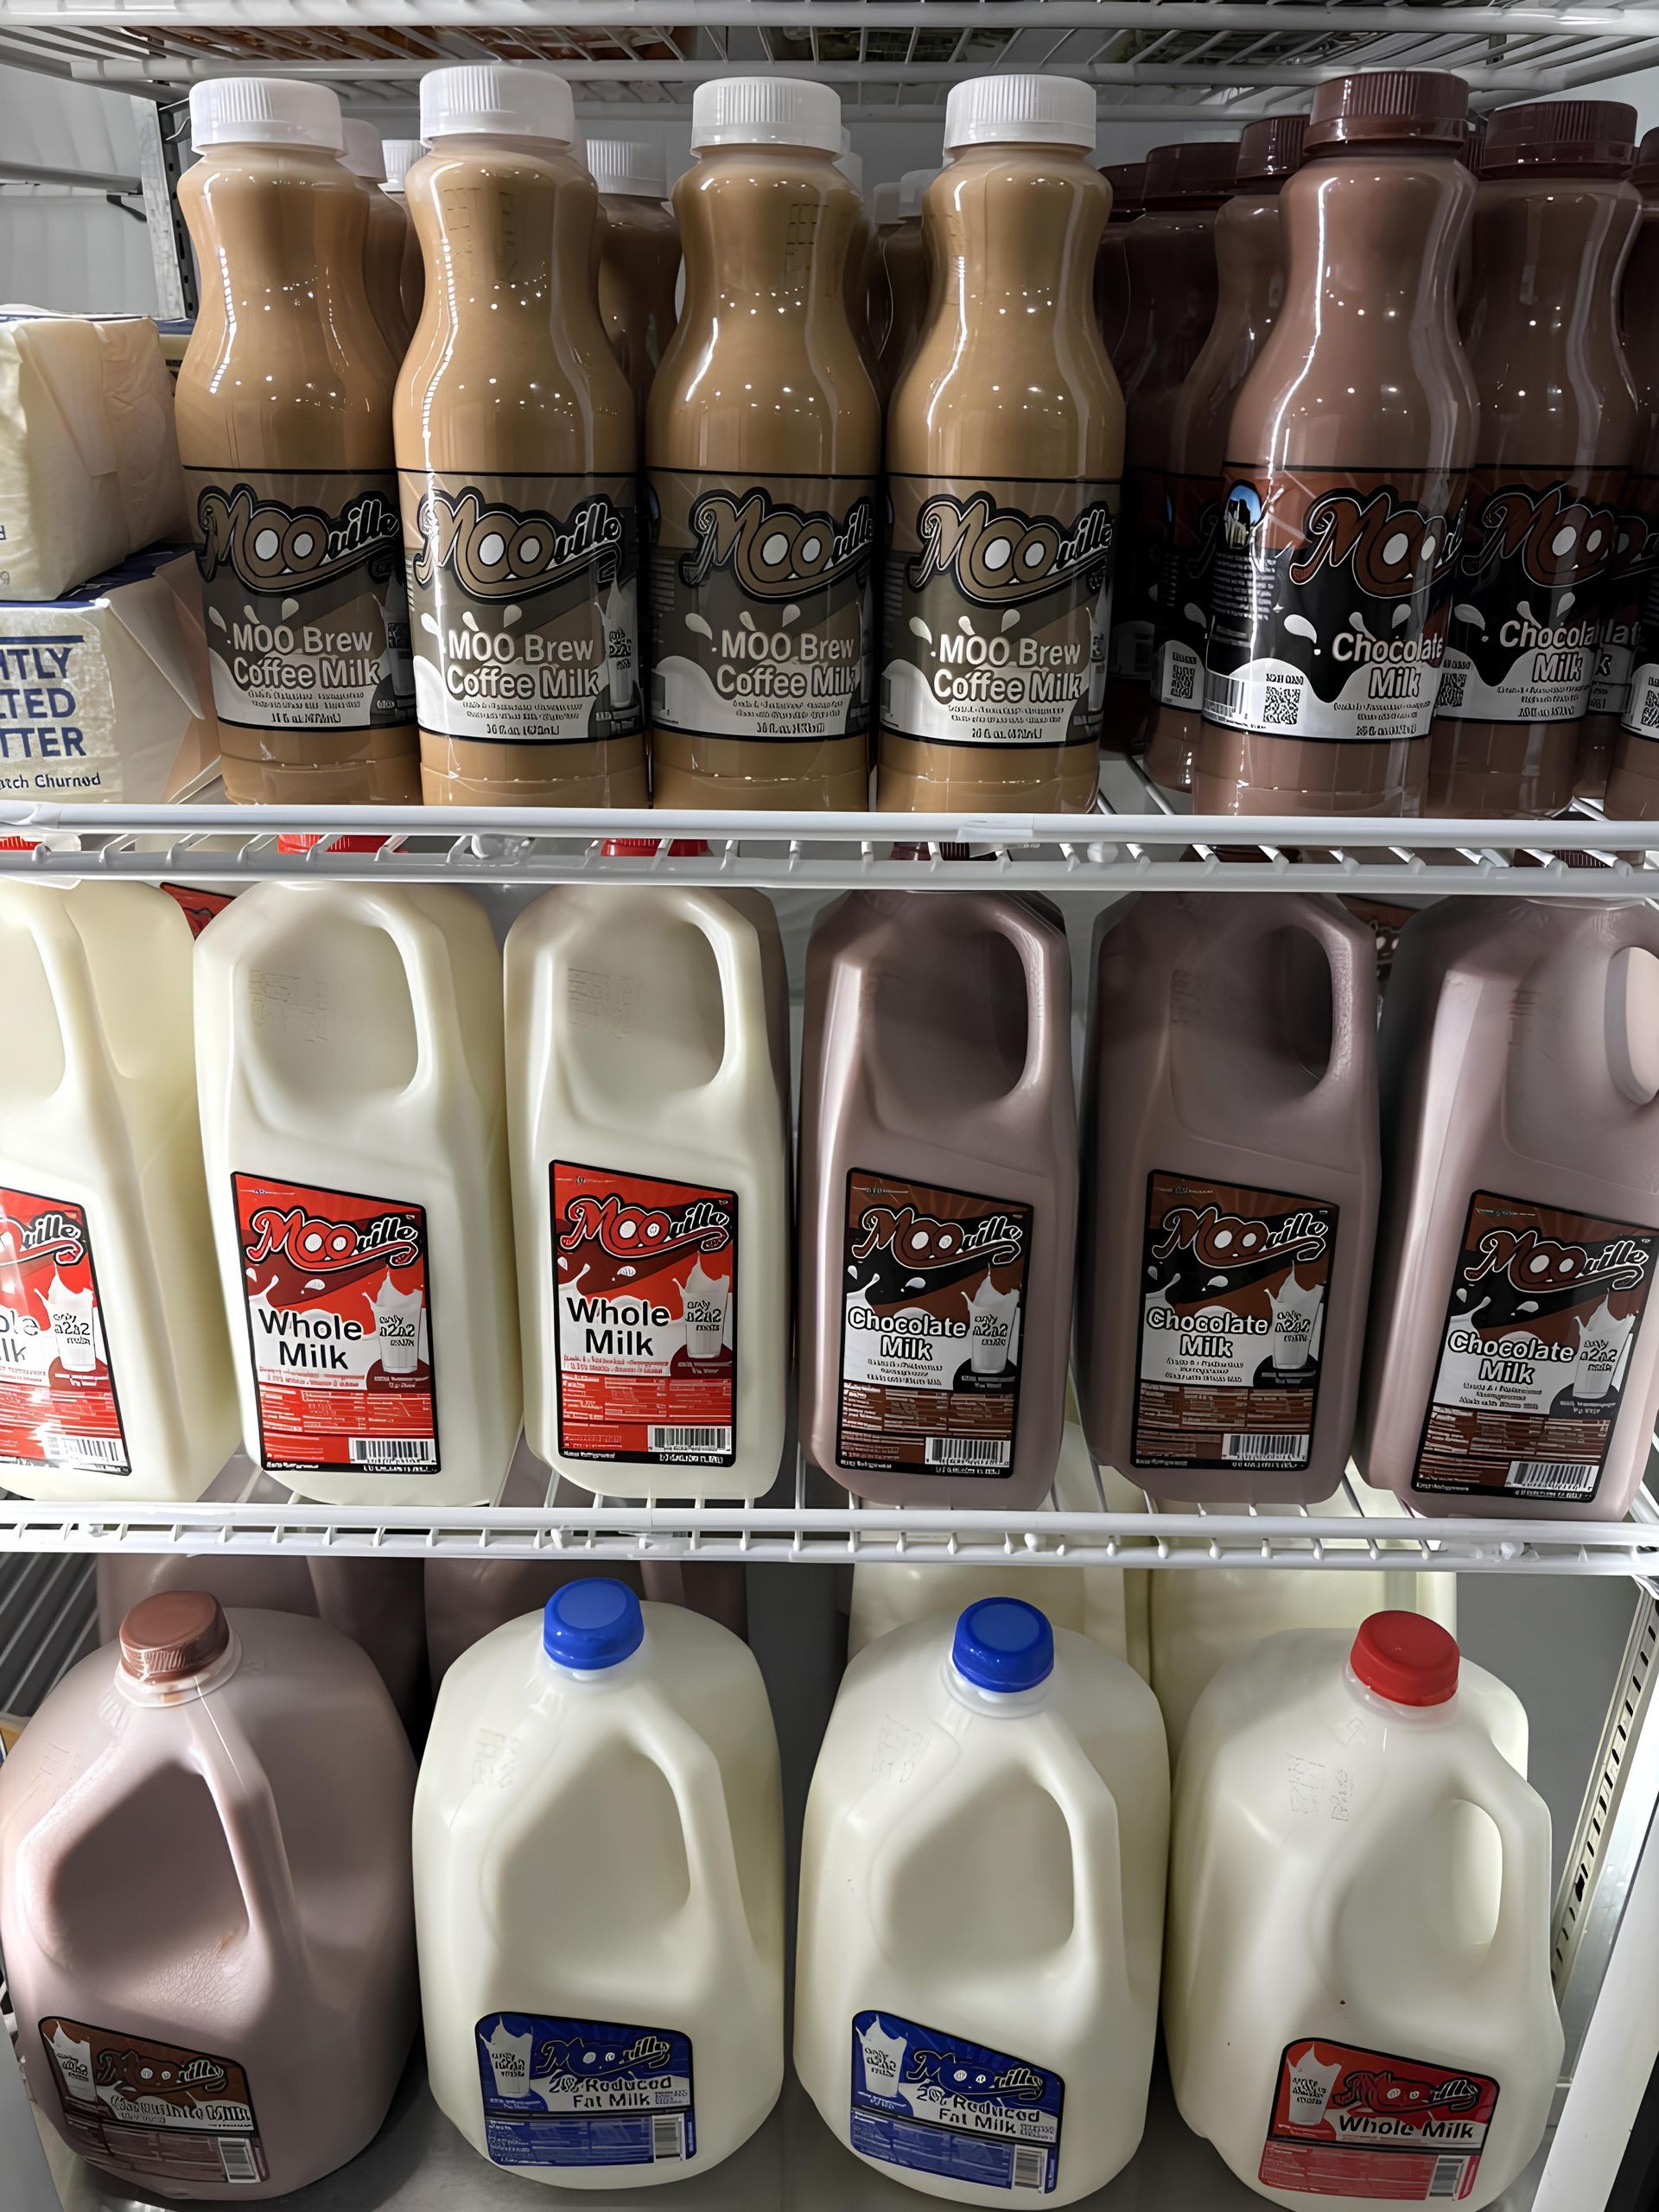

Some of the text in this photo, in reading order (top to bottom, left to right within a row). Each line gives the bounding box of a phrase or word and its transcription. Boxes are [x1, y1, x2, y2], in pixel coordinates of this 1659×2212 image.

[232, 624, 374, 654] MOO Brew
[448, 629, 516, 664] MOO
[524, 633, 594, 663] Brew
[721, 629, 855, 662] MOO Brew
[939, 633, 1082, 667] MOO Brew
[1332, 632, 1444, 663] Chocolate
[232, 656, 381, 688] Coffee Milk
[446, 665, 600, 699] Coffee Milk
[715, 664, 807, 697] Coffee
[1369, 666, 1421, 699] Milk
[1533, 652, 1583, 683] Milk
[934, 671, 1084, 703] Coffee Milk
[0, 728, 87, 757] TTER
[246, 1209, 418, 1272] Mooville
[560, 1197, 729, 1259] Mooville
[851, 1205, 1023, 1270] Mooville
[1152, 1206, 1329, 1269] Mooville
[1464, 1230, 1649, 1293] Mooville
[258, 1308, 363, 1341] Whole
[566, 1297, 671, 1327] Whole
[848, 1307, 968, 1338] Chocolate
[1147, 1307, 1270, 1336] Chocolate
[279, 1341, 348, 1370] Milk
[585, 1328, 655, 1357] Milk
[880, 1337, 933, 1361] Milk
[1179, 1335, 1234, 1358] Milk
[1447, 1329, 1575, 1363] Chocolate
[1478, 1357, 1535, 1385] Milk
[573, 2093, 652, 2108] Fat Milk
[939, 2107, 1017, 2135] Fat Milk
[1339, 2114, 1474, 2139] Whole Milk
